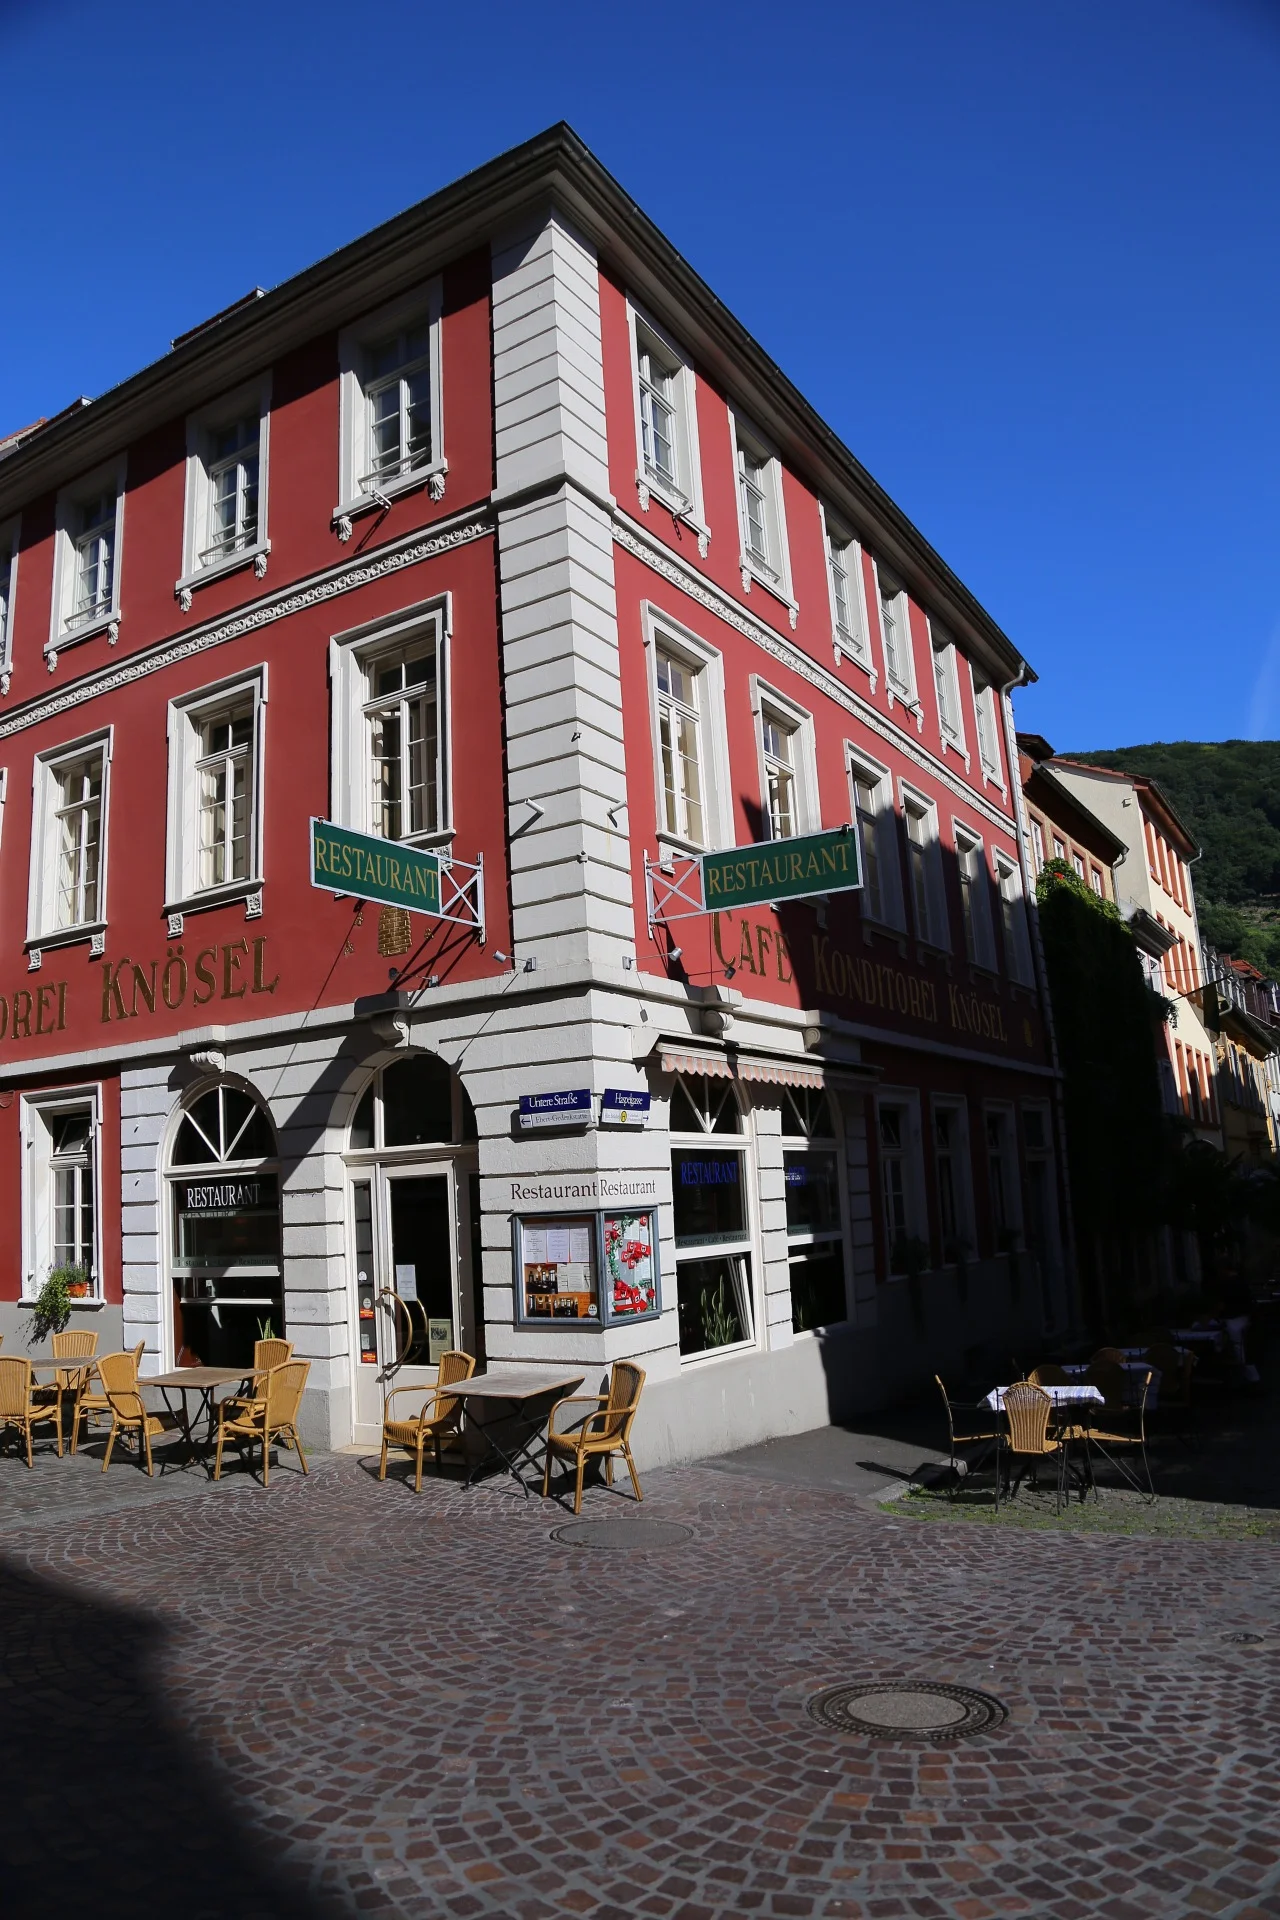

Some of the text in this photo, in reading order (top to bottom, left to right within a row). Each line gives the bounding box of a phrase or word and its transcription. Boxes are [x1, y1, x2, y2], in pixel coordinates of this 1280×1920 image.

[315, 837, 437, 899] RESTAURANT
[707, 843, 850, 895] RESTAURANT
[102, 936, 280, 1022] KNÖSEL
[811, 934, 937, 1023] KONDITOREI
[948, 983, 1007, 1043] KNÖSEL
[529, 1092, 578, 1108] Untere Straße
[681, 1161, 738, 1185] RESTAURANT
[187, 1184, 260, 1208] RESTAURANT
[510, 1182, 597, 1199] Restaurant
[600, 1179, 656, 1196] Restaurant
